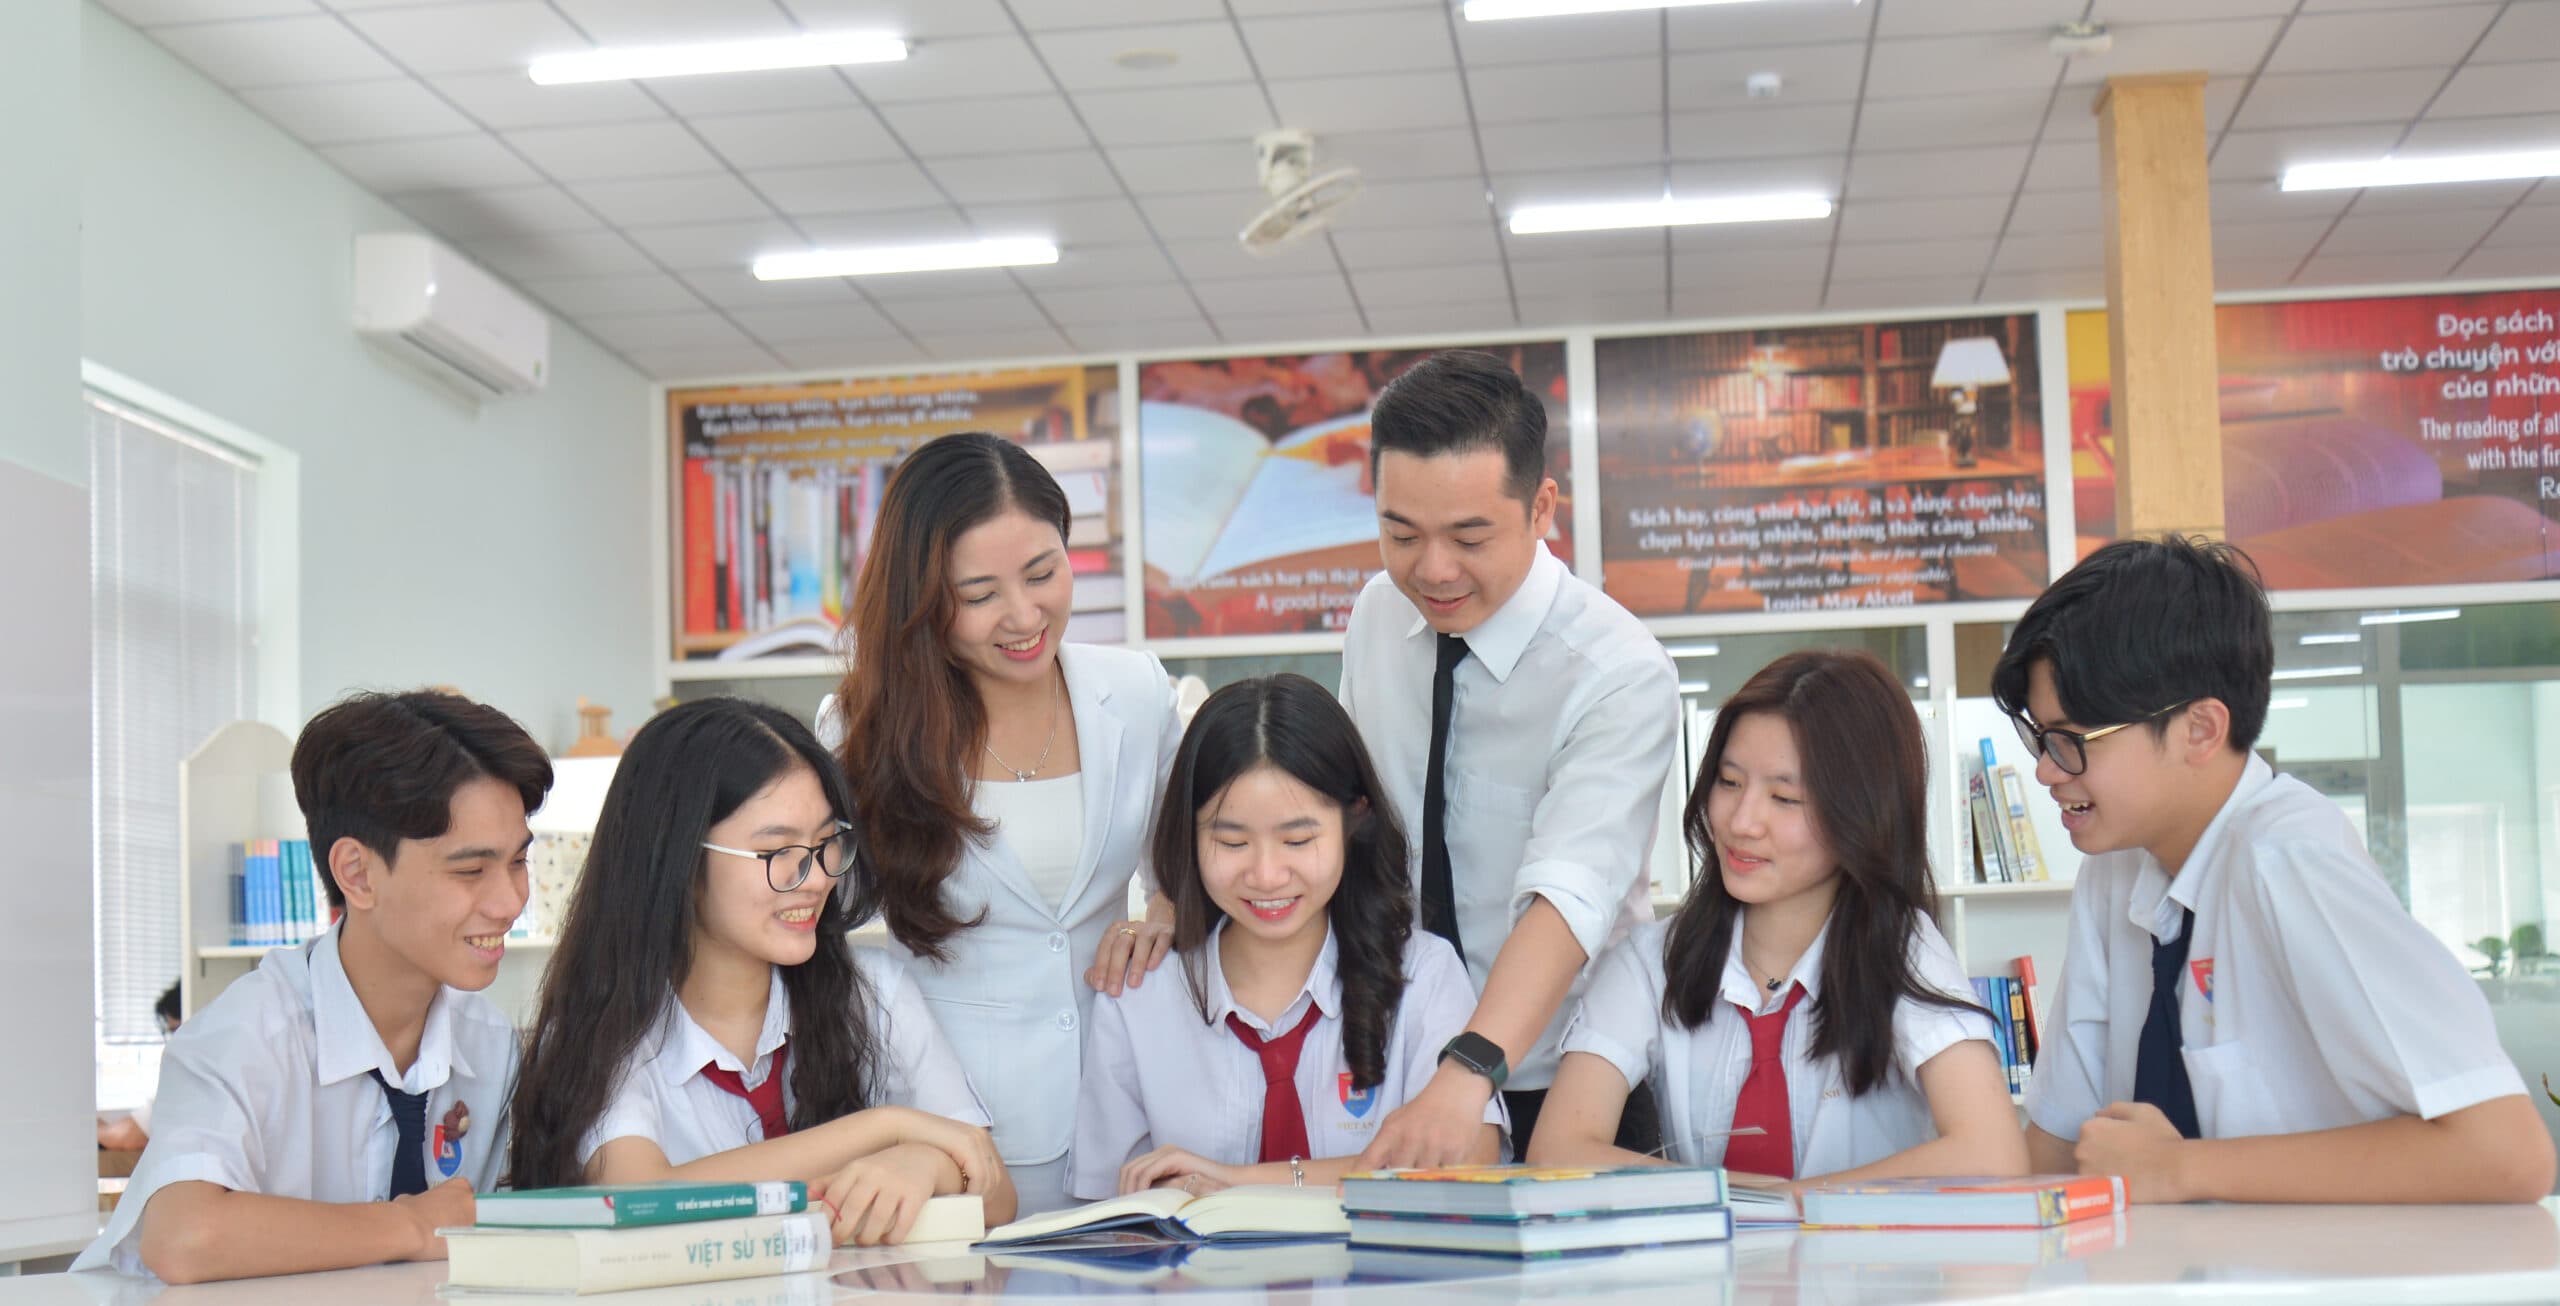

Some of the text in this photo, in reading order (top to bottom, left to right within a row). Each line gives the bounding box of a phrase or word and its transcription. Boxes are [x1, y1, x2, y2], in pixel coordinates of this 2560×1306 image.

[2437, 308, 2555, 341] Đọc sách
[2380, 345, 2420, 372] trò
[2425, 343, 2520, 373] chuyện
[2441, 372, 2490, 400] của
[2419, 411, 2560, 443] The reading of al
[2466, 446, 2506, 470] with
[2509, 444, 2539, 468] the
[1630, 507, 1671, 528] Sách
[1674, 506, 1710, 528] hay,
[1713, 503, 1757, 527] cũng
[1759, 501, 1796, 521] như
[1799, 500, 1832, 522] bạn
[1836, 495, 1865, 517] tốt,
[1886, 496, 1907, 514] và
[1911, 493, 1955, 516] được
[1959, 490, 2003, 514] chọn
[1639, 509, 2034, 552] chọn lựa càng nhiều, thưởng thức càng nhiều.
[1255, 591, 1270, 612] A
[1271, 590, 1318, 617] good
[1763, 589, 1916, 612] Louisa May Alcott
[686, 1237, 724, 1269] VIỆT
